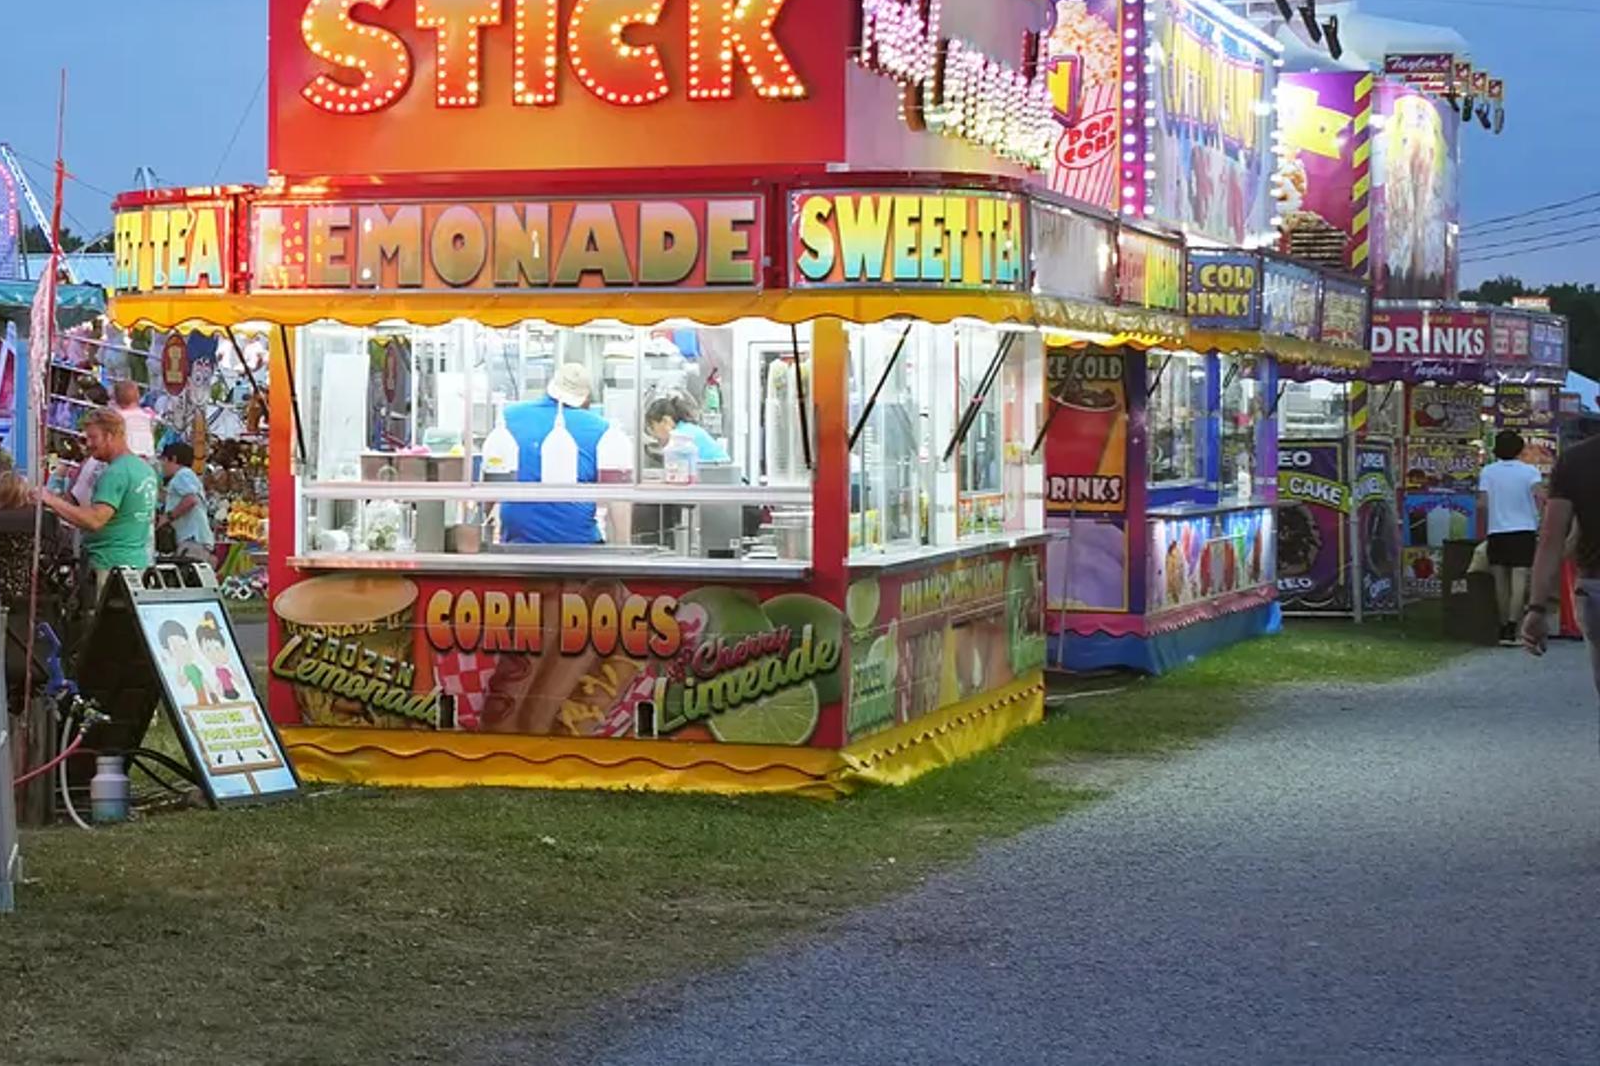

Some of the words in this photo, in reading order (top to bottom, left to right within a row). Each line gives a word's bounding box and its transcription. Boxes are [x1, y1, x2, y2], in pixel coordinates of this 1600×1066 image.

[151, 209, 223, 286] TEA
[257, 202, 755, 286] LEMONADE
[797, 195, 967, 282] SWEET
[1072, 356, 1123, 379] COLD
[1371, 326, 1485, 356] DRINKS
[1045, 476, 1121, 501] RINKS
[1289, 477, 1342, 506] CAKE
[426, 588, 544, 654] CORN
[560, 591, 682, 659] DOGS
[692, 624, 793, 679] Cherry
[305, 631, 415, 687] FROZEN
[654, 624, 839, 733] Limeade
